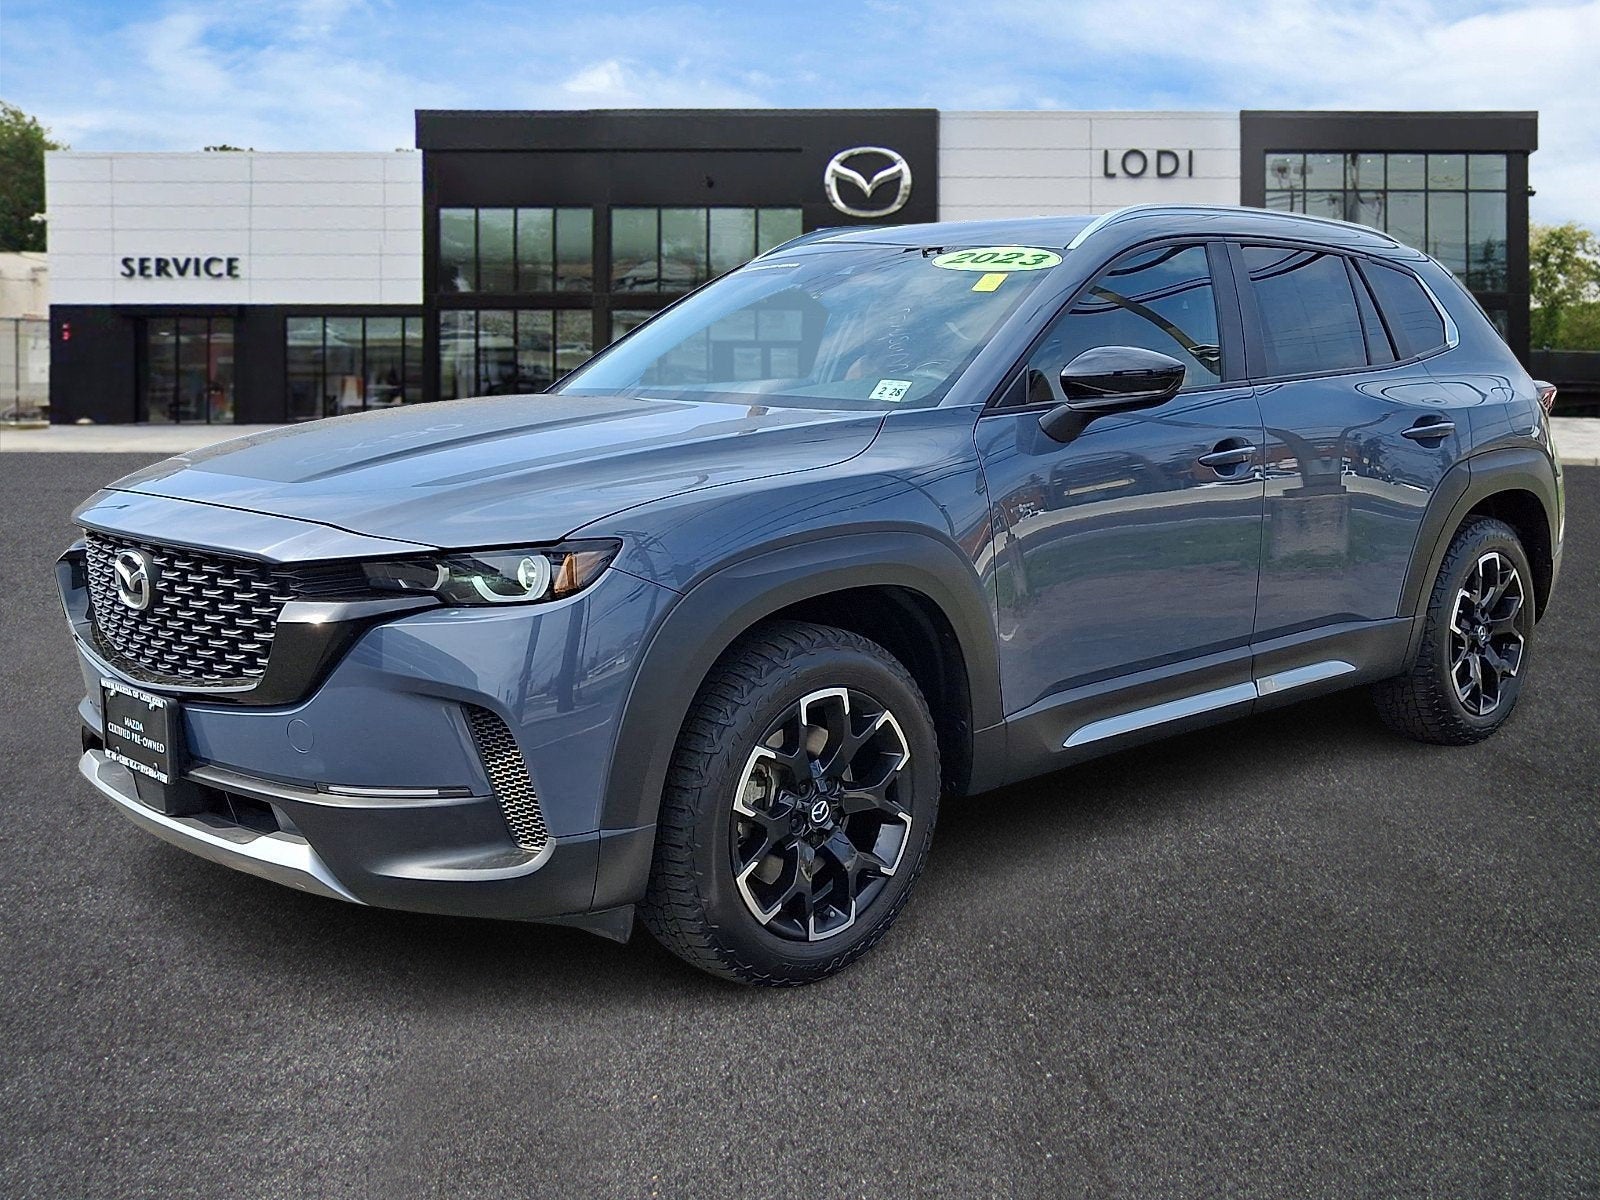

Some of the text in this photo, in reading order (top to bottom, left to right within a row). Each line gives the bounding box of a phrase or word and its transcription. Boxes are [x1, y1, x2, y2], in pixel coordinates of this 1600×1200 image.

[1103, 148, 1193, 178] LODI
[120, 256, 240, 278] SERVICE
[943, 252, 1051, 266] 2023
[877, 386, 888, 395] 2
[124, 716, 144, 733] MAZDA
[131, 732, 166, 754] PRE-OWNED
